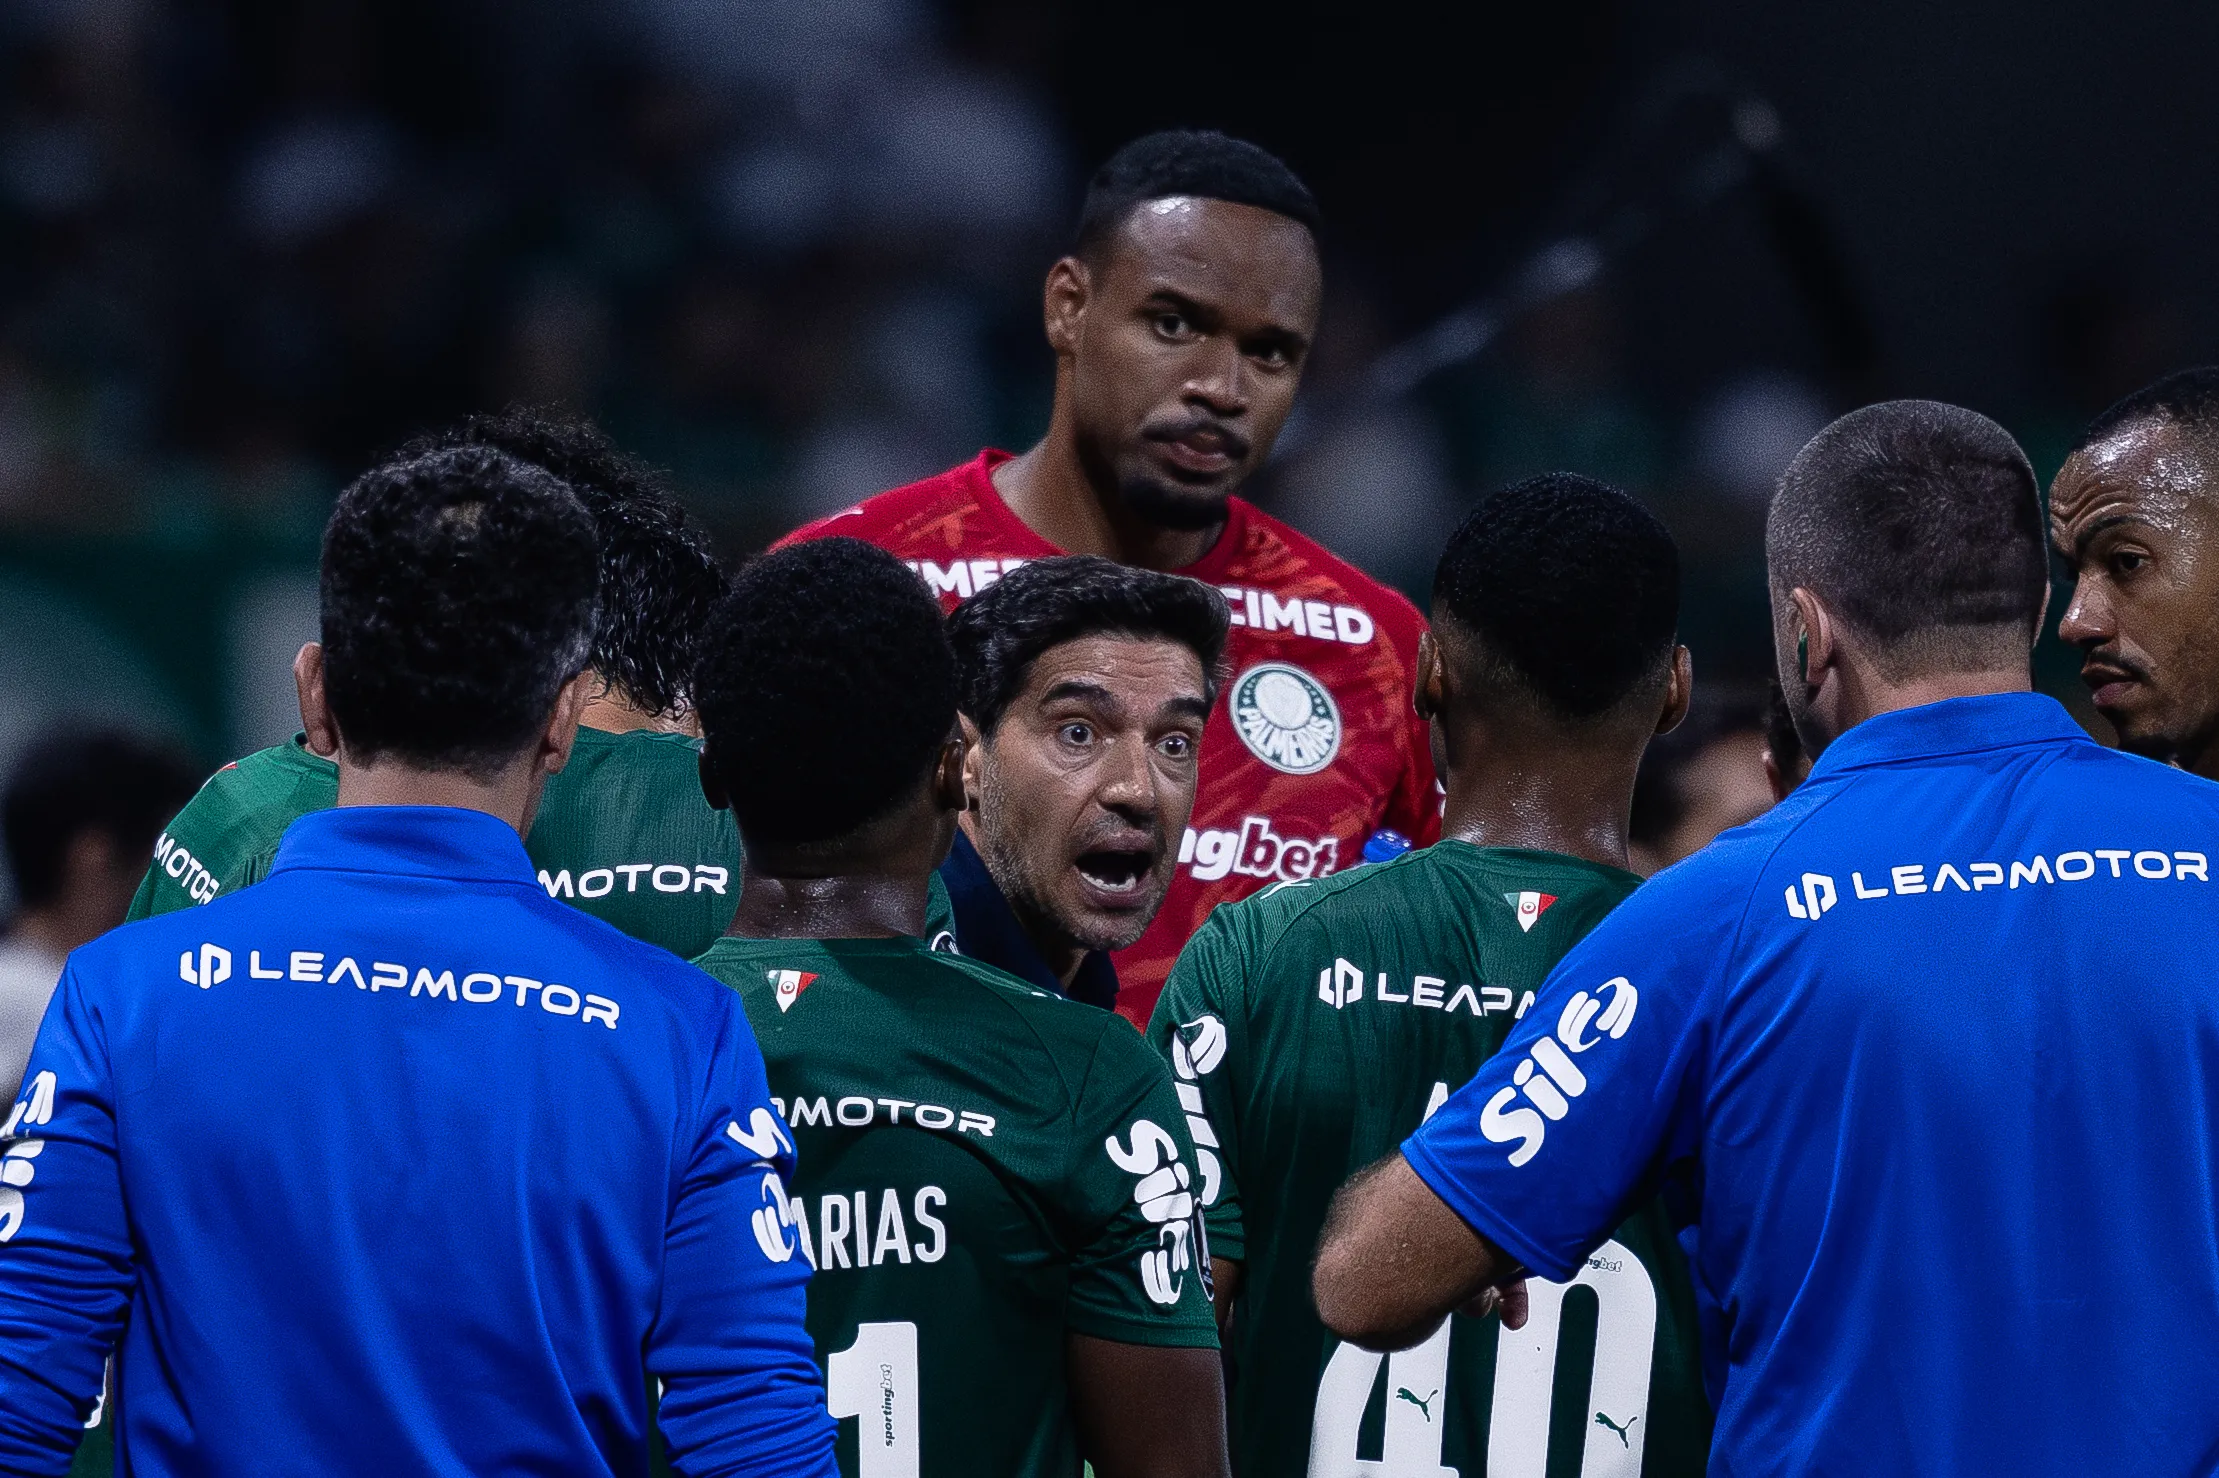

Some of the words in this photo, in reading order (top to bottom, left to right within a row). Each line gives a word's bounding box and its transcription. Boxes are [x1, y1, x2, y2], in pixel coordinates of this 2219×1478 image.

[1238, 707, 1335, 767] PALMEIRAS
[1851, 849, 2209, 900] LEAPMOTOR
[249, 950, 621, 1030] LEAPMOTOR
[880, 1363, 895, 1448] sportingbet
